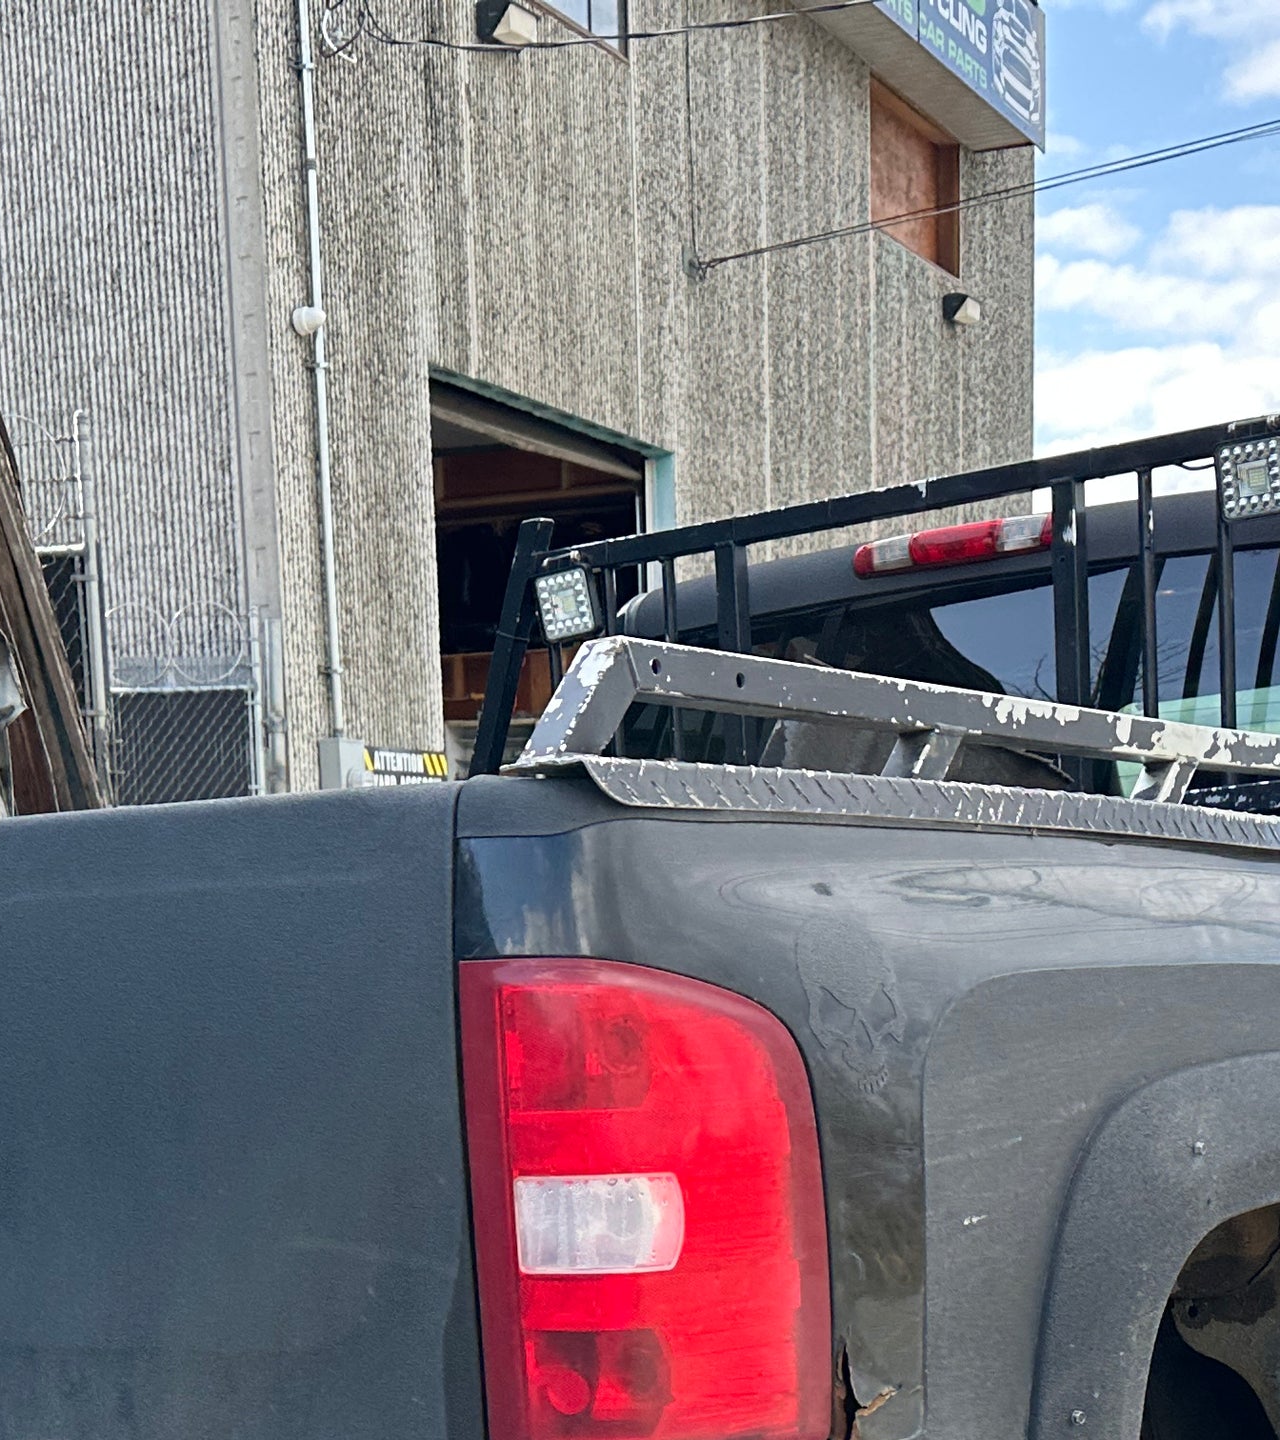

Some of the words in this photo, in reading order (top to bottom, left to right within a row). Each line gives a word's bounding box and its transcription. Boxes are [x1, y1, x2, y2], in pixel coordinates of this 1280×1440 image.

[919, 11, 945, 53] CAR
[948, 38, 987, 90] PARTS
[929, 0, 988, 54] CLING
[374, 750, 425, 773] ATTENTION
